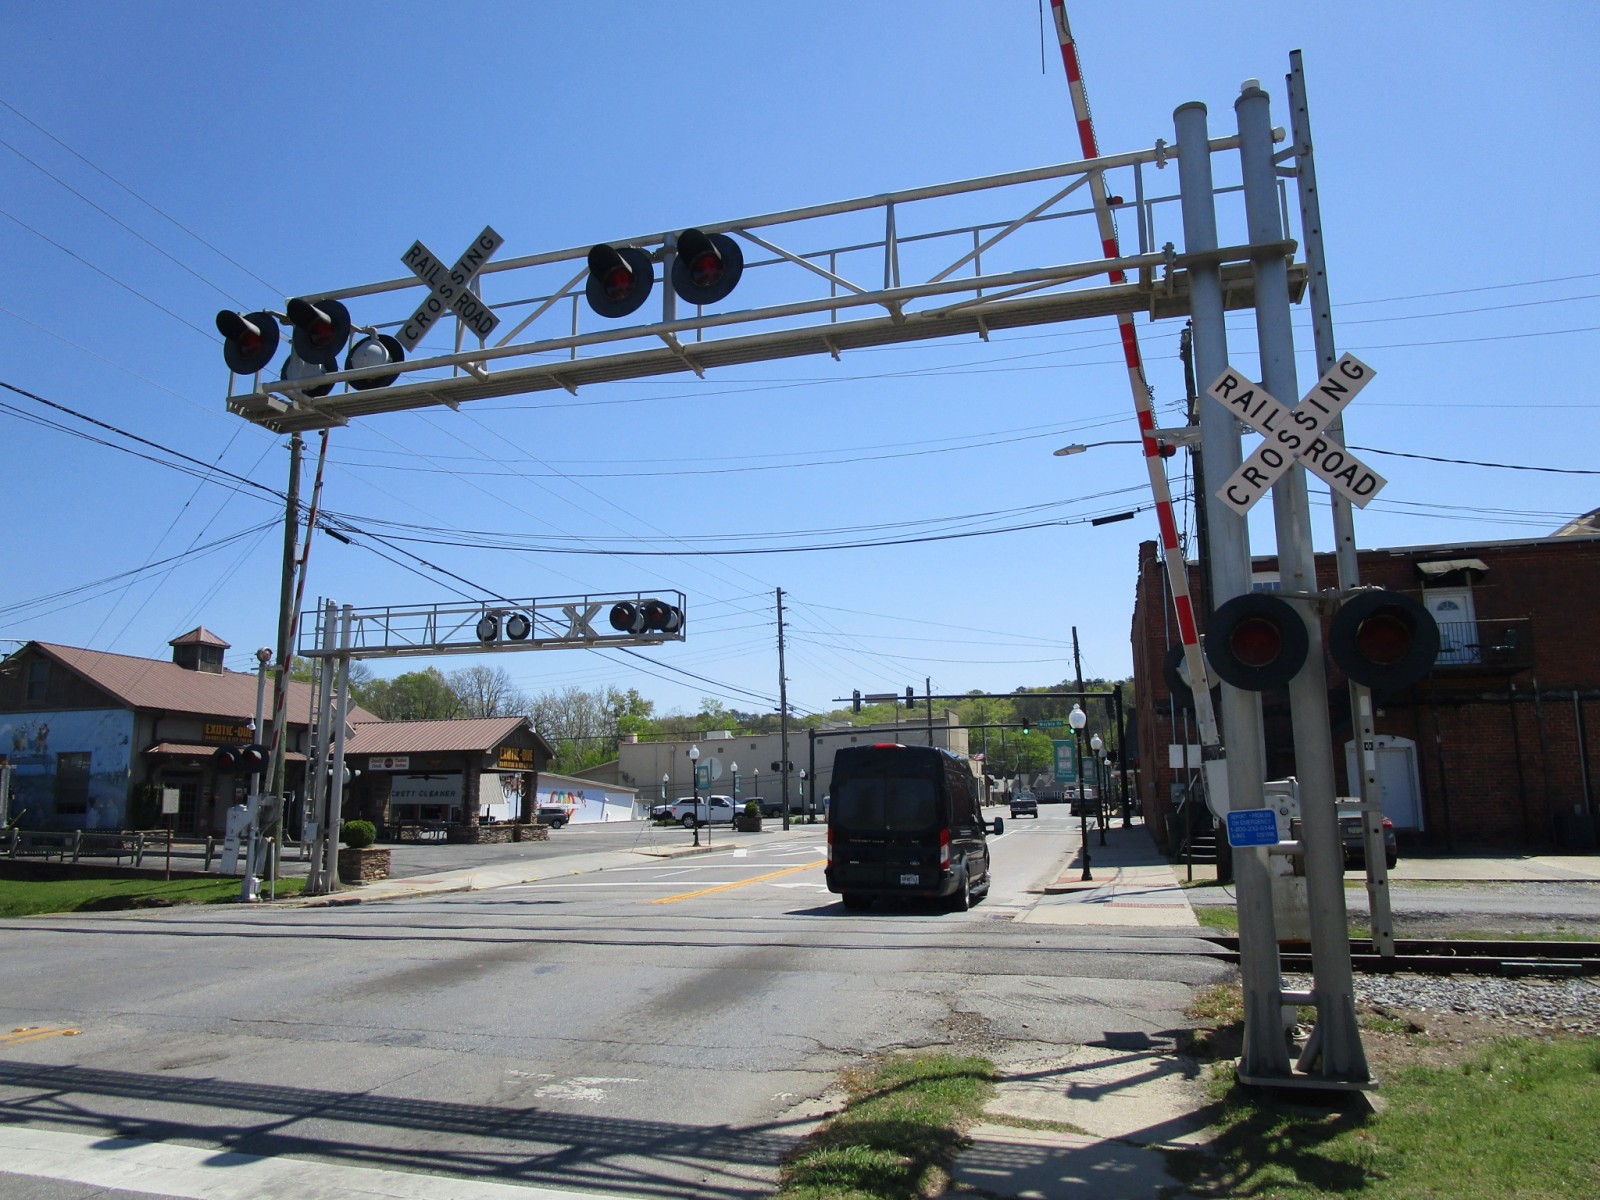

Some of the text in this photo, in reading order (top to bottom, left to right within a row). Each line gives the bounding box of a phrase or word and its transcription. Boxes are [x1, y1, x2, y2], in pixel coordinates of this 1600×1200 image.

[405, 236, 494, 340] CROSSING
[406, 245, 493, 334] RAIL ROAD
[1215, 374, 1377, 496] RAIL ROAD
[1226, 360, 1364, 506] CROSSING
